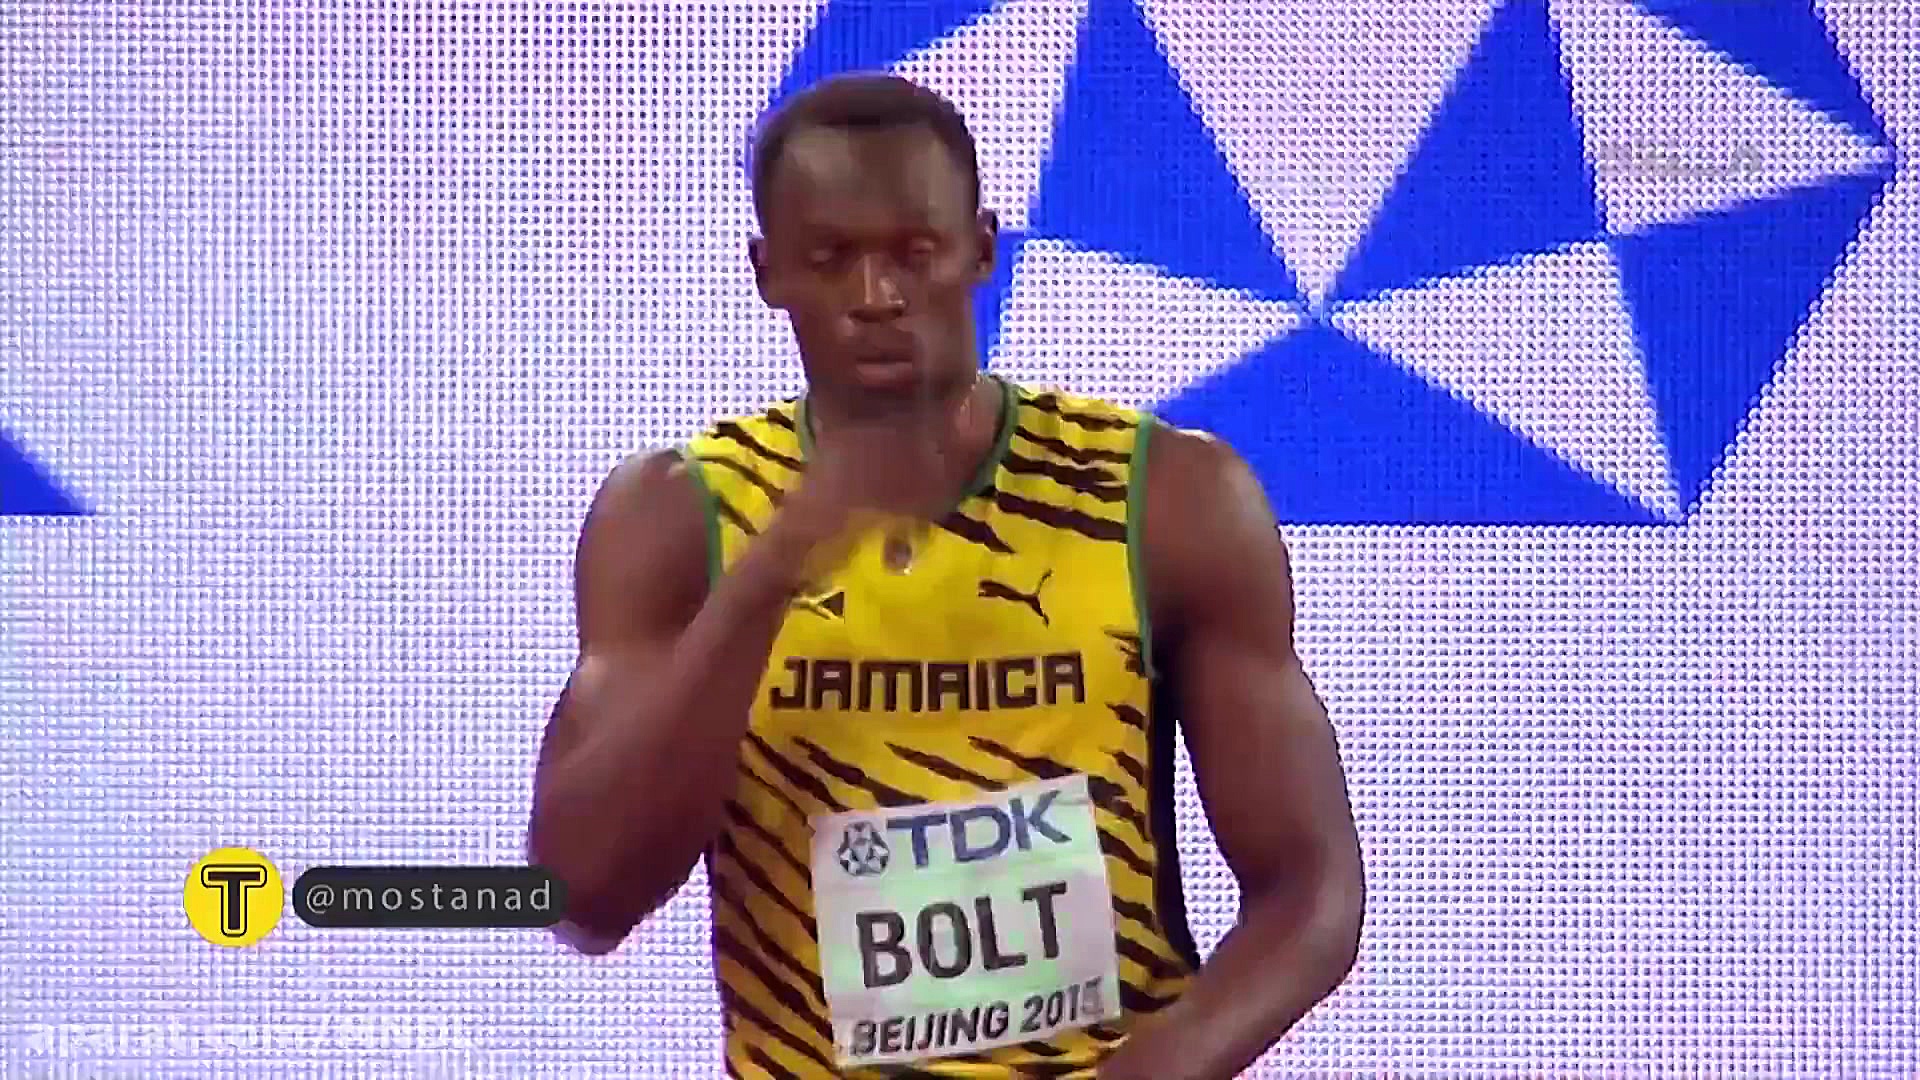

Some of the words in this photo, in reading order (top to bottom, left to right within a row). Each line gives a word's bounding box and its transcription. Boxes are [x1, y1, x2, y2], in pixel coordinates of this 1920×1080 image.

[769, 650, 1087, 713] JAMAICA
[886, 789, 1073, 871] TDK
[855, 880, 1068, 990] BOLT
[850, 999, 1010, 1057] BEIJING
[1019, 975, 1105, 1034] 2015
